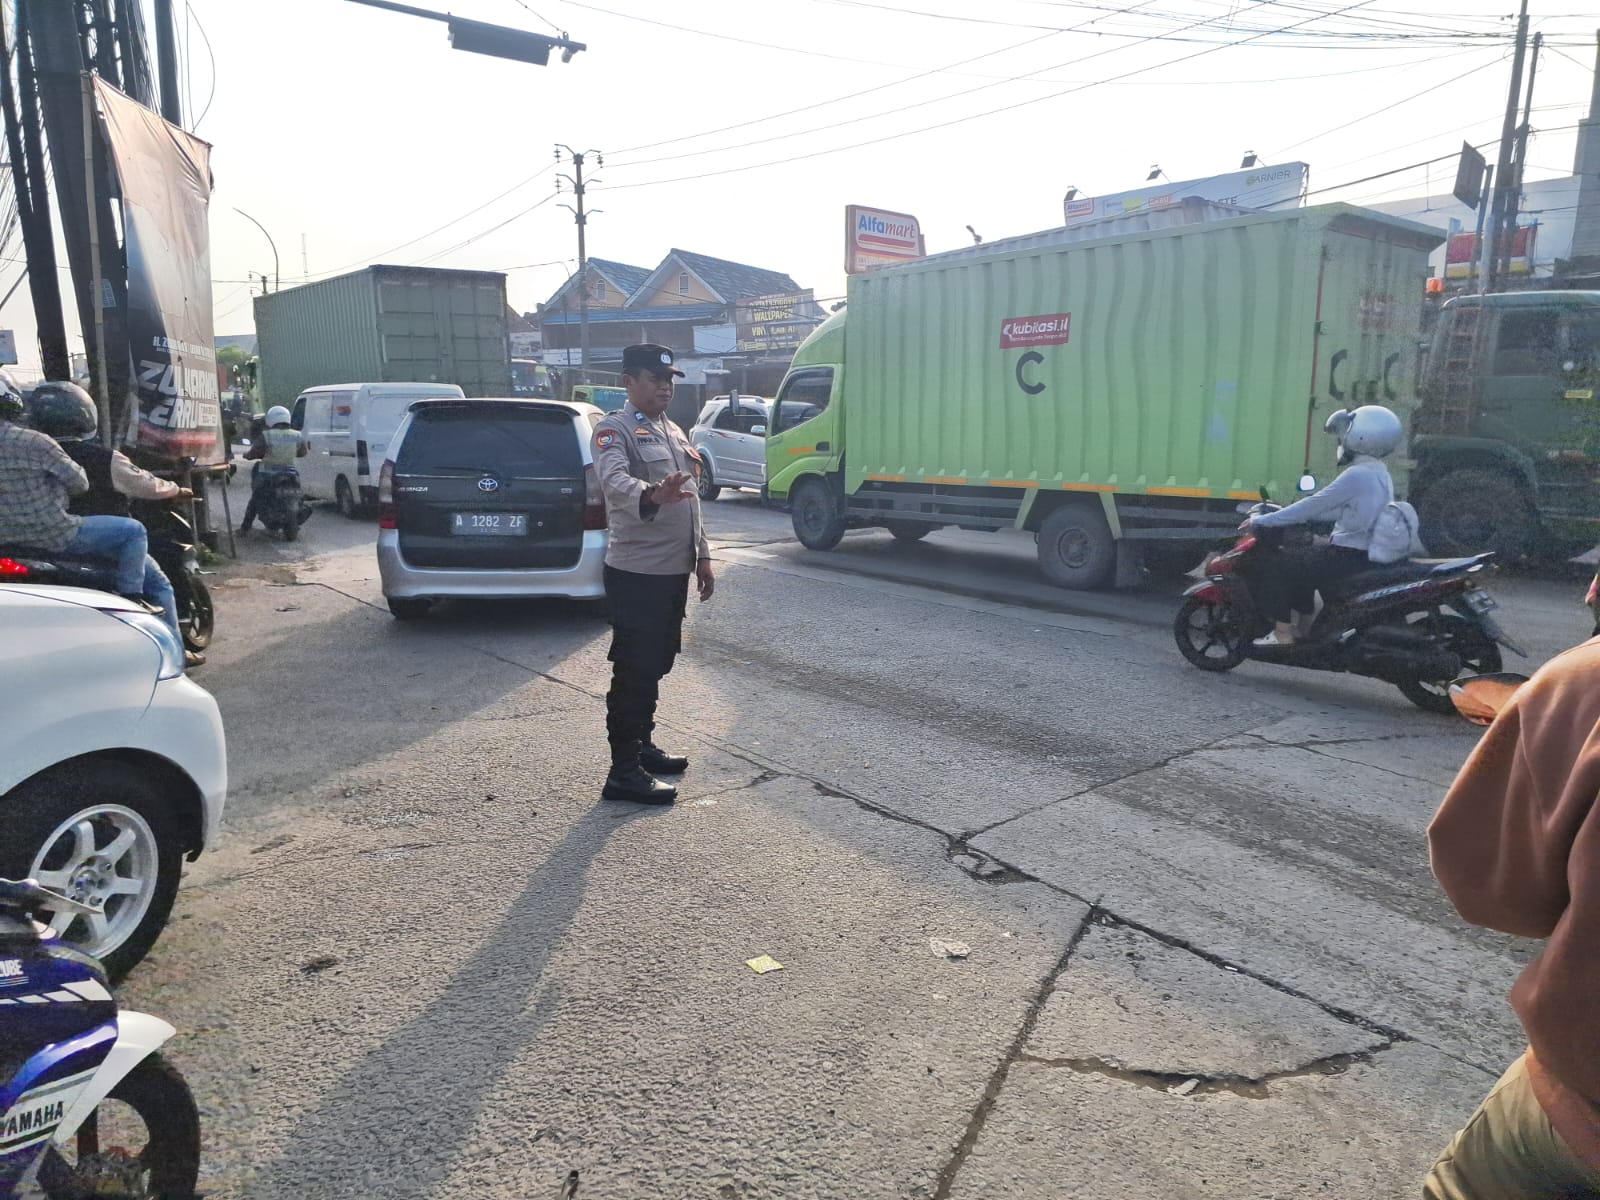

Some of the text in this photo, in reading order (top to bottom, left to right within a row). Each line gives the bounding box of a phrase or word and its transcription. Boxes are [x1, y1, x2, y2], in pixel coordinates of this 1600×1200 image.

[858, 214, 915, 239] Alfamart
[1015, 350, 1046, 395] C
[456, 514, 523, 527] A 1282 ZF
